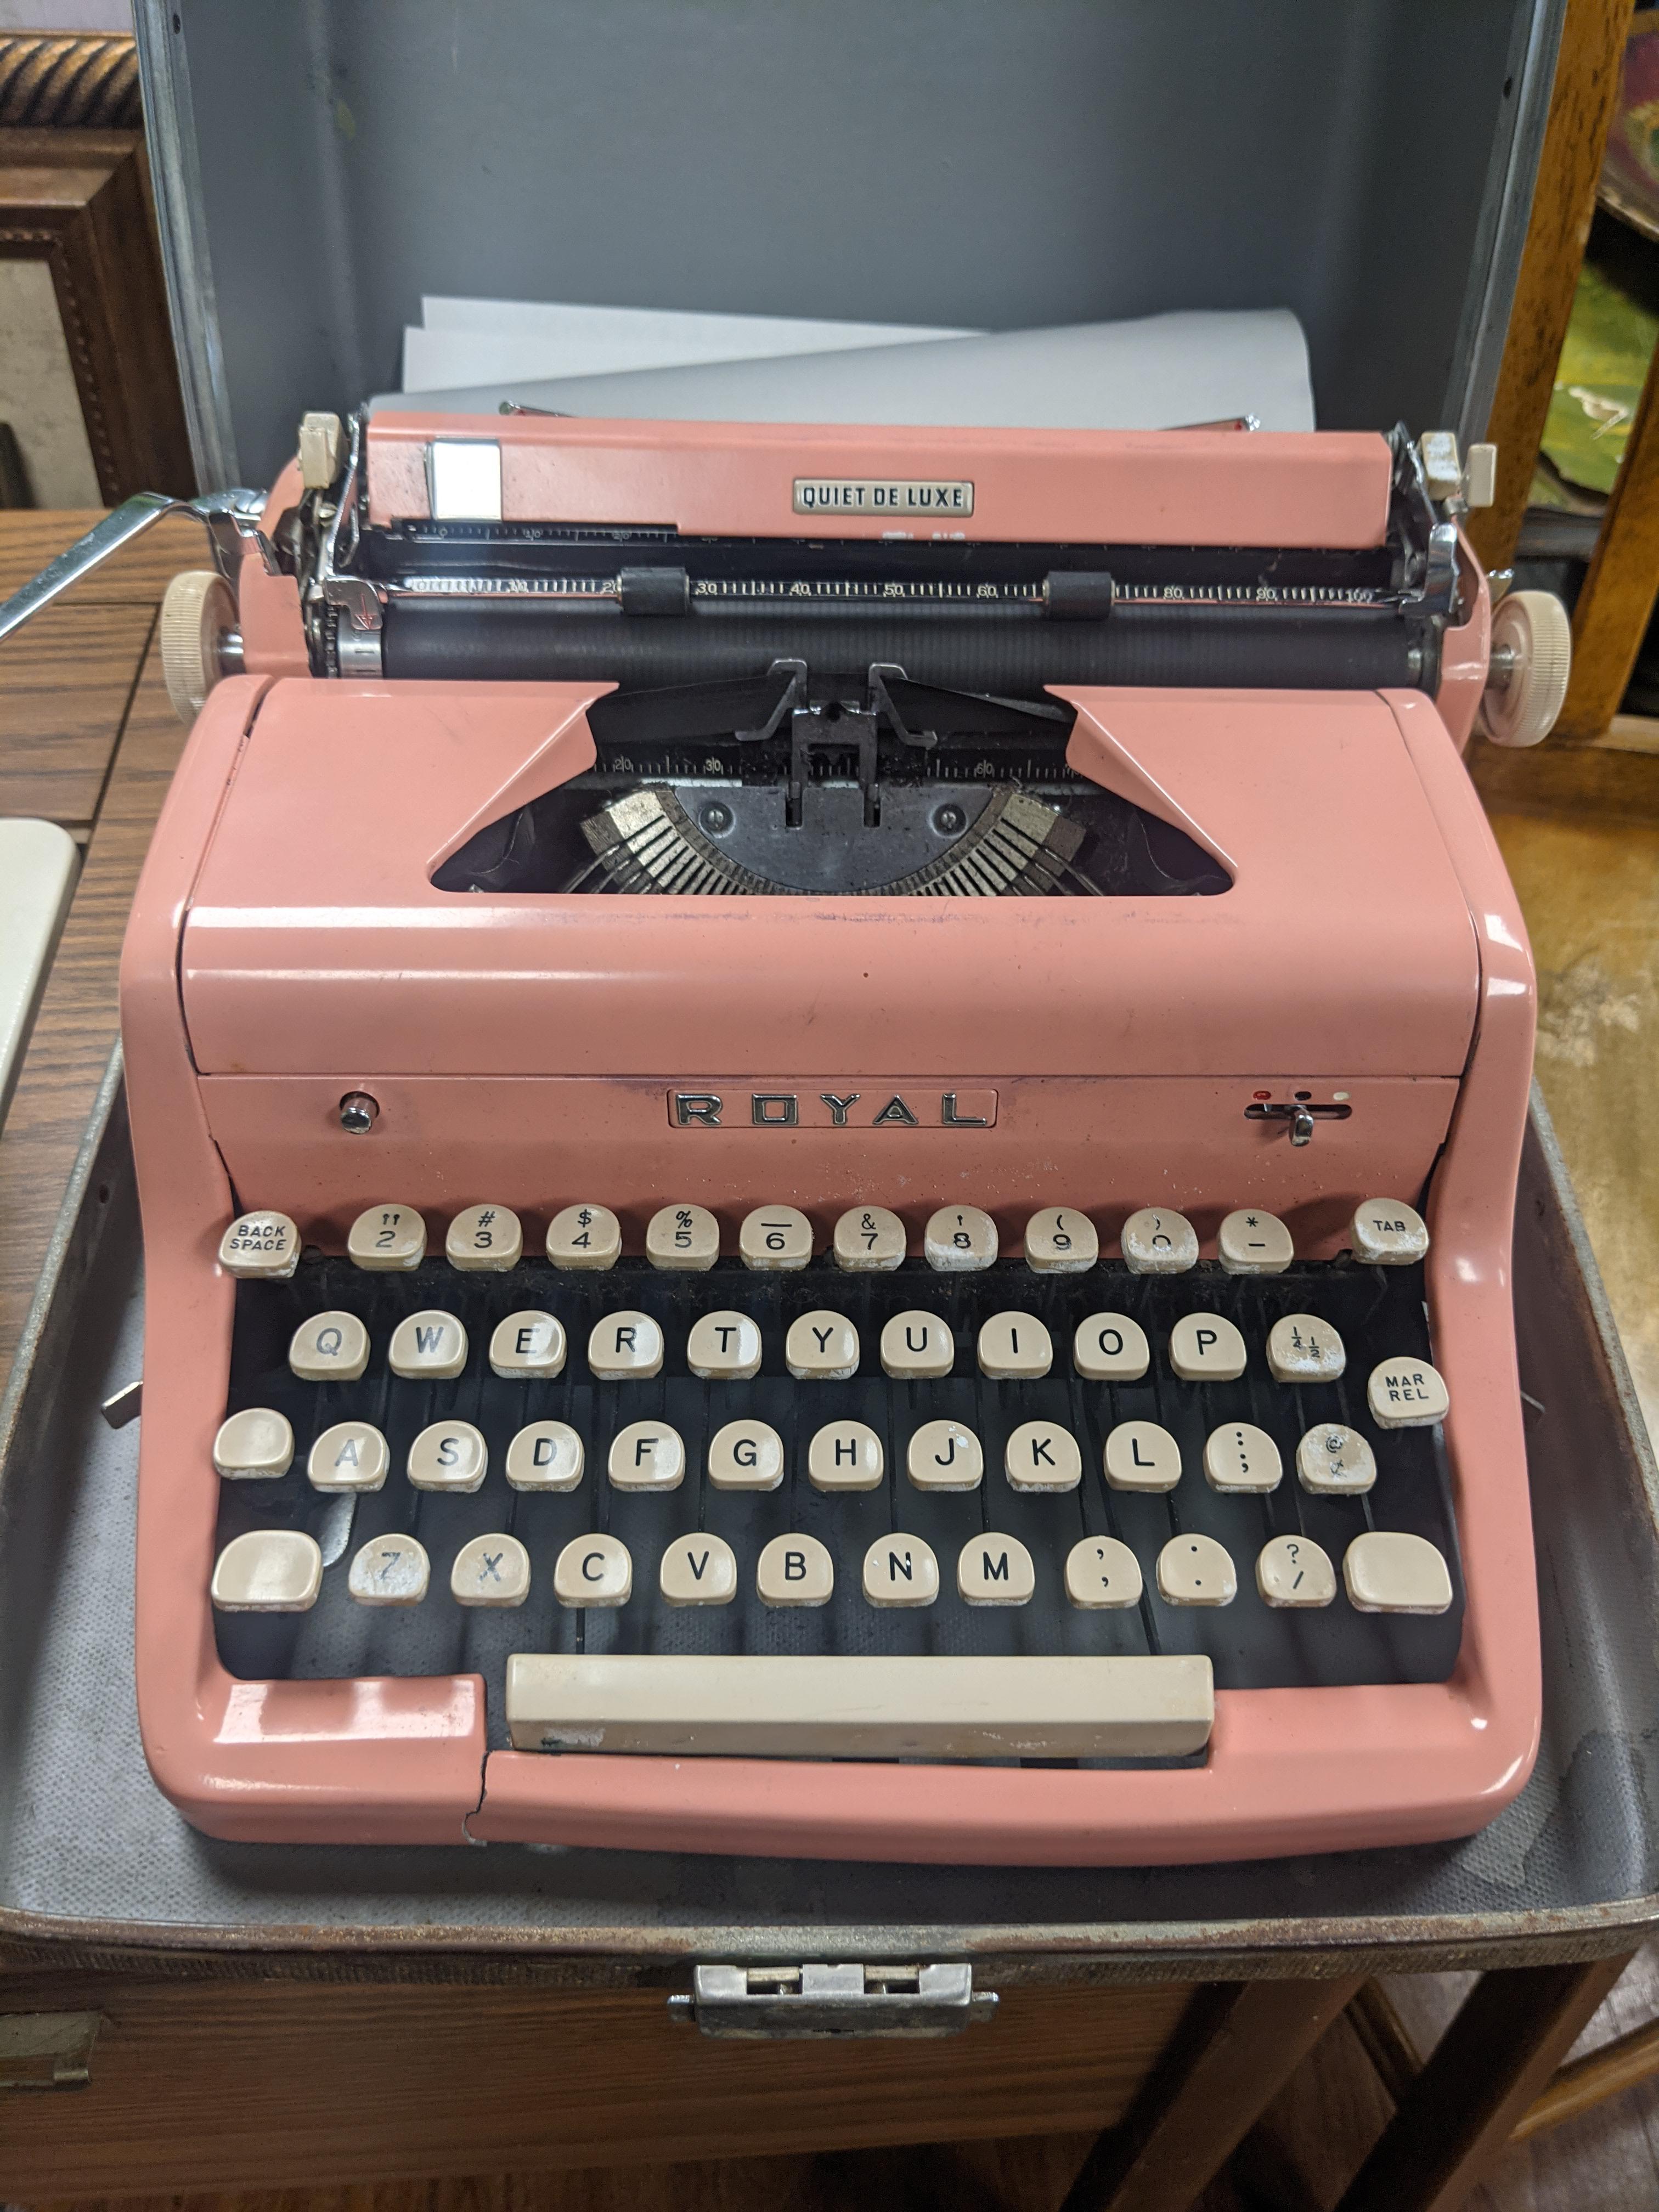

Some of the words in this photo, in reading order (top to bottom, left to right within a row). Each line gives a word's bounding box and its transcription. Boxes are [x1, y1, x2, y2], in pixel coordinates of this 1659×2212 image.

[803, 487, 866, 509] QUIET
[873, 487, 898, 506] DE
[908, 488, 963, 507] LUXE
[697, 583, 717, 594] 30
[790, 583, 810, 595] 40
[884, 584, 904, 595] 50
[977, 584, 997, 596] 60
[1164, 586, 1183, 599] 80
[1256, 587, 1277, 600] 90
[614, 758, 631, 771] 20
[706, 760, 721, 771] 30
[675, 1093, 987, 1125] ROYAL
[478, 1211, 495, 1227] #
[578, 1209, 591, 1227] $
[675, 1210, 693, 1228] %
[861, 1213, 876, 1230] &
[1373, 1220, 1406, 1232] TAB
[238, 1225, 285, 1237] BACK
[375, 1231, 396, 1248] 2
[474, 1232, 493, 1249] 3
[572, 1232, 591, 1249] 4
[675, 1231, 692, 1248] 5
[766, 1232, 785, 1250] 6
[860, 1233, 878, 1250] 7
[953, 1232, 971, 1249] 8
[1053, 1234, 1071, 1250] 9
[230, 1238, 287, 1250] SPACE
[316, 1328, 342, 1356] Q
[415, 1327, 444, 1353] W
[515, 1328, 540, 1353] E
[616, 1327, 636, 1353] R
[715, 1327, 737, 1353] T
[812, 1327, 833, 1353] Y
[906, 1327, 927, 1352] U
[1011, 1328, 1018, 1353] I
[1098, 1329, 1123, 1355] O
[1196, 1329, 1217, 1355] P
[1385, 1373, 1425, 1387] MAR
[1389, 1388, 1429, 1401] REL
[335, 1439, 359, 1467] A
[437, 1438, 460, 1466] S
[533, 1437, 557, 1466] D
[635, 1438, 659, 1466] F
[733, 1438, 757, 1466] G
[835, 1438, 856, 1466] H
[935, 1437, 955, 1465] J
[1032, 1438, 1056, 1466] K
[1132, 1438, 1155, 1467] L
[687, 1551, 709, 1580] V
[785, 1551, 806, 1580] B
[889, 1551, 912, 1581] N
[983, 1551, 1009, 1580] M
[1286, 1543, 1300, 1564] ?
[479, 1552, 503, 1582] X
[582, 1552, 605, 1581] C
[1293, 1570, 1304, 1590] /
